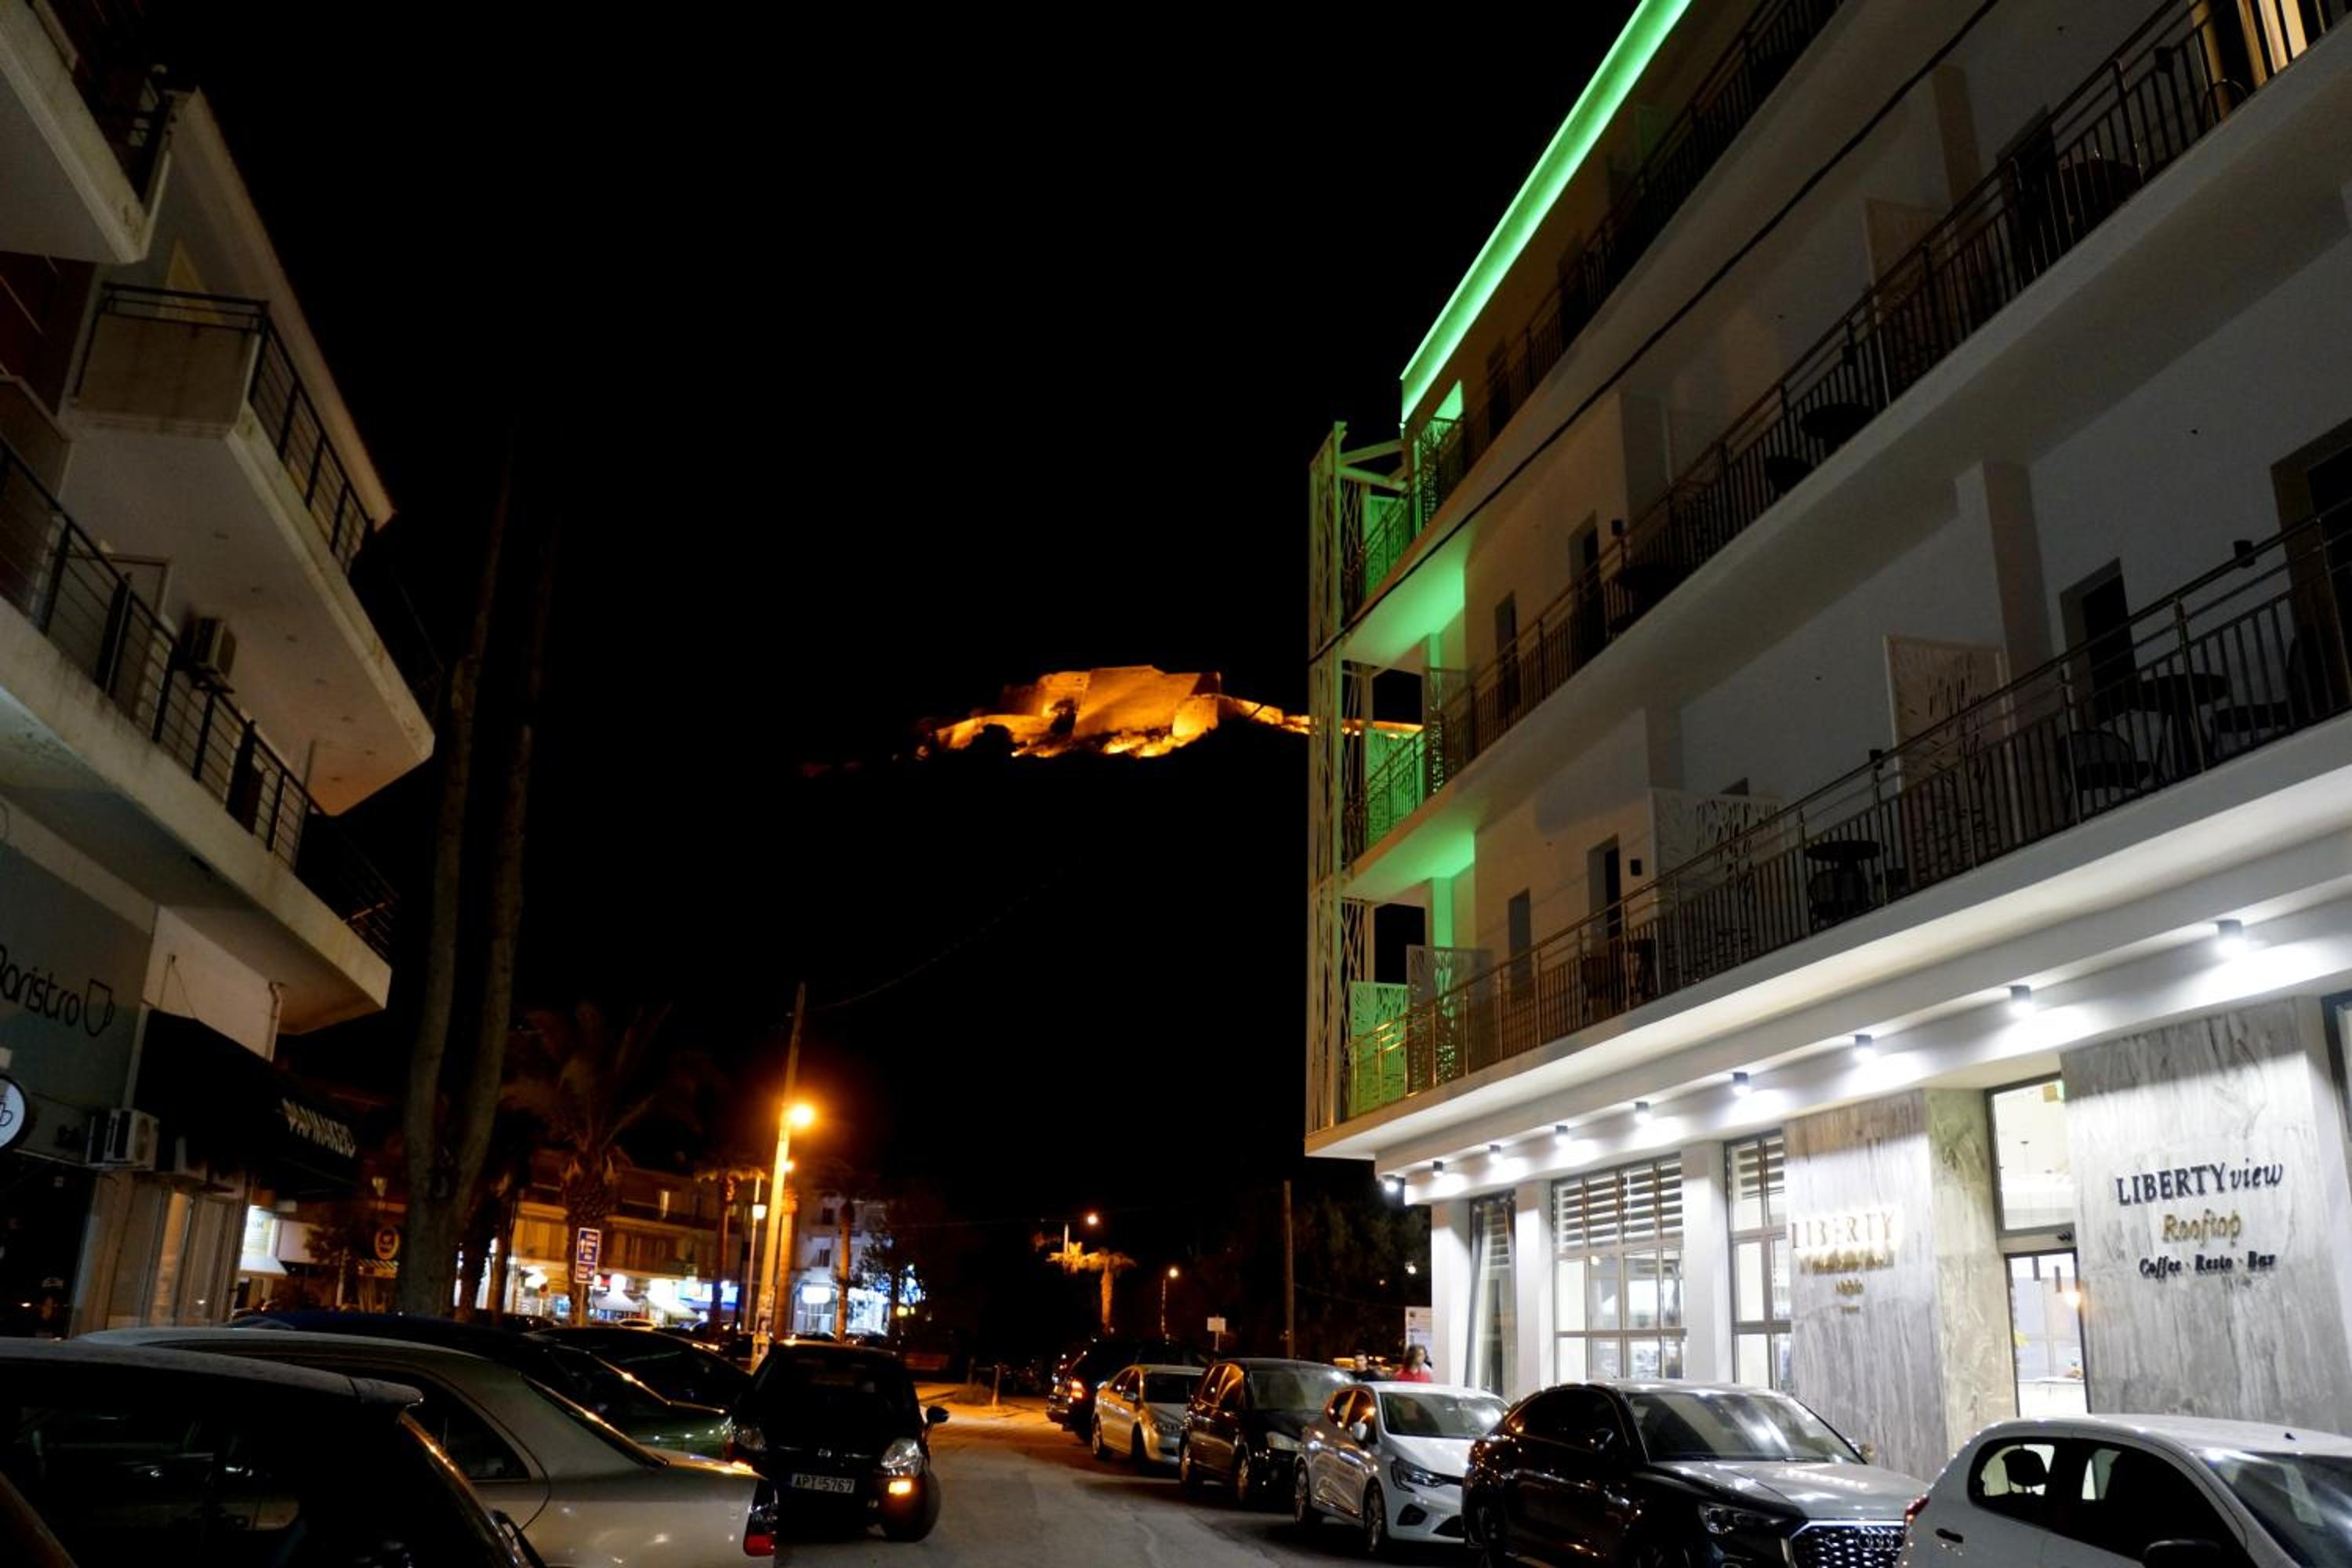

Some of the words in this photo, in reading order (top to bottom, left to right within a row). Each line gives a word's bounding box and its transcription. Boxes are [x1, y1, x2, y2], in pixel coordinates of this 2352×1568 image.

[2161, 1208, 2241, 1247] Rooftop
[2140, 1255, 2183, 1279] Coffee
[2195, 1254, 2234, 1273] Resto
[2248, 1250, 2277, 1269] Bar
